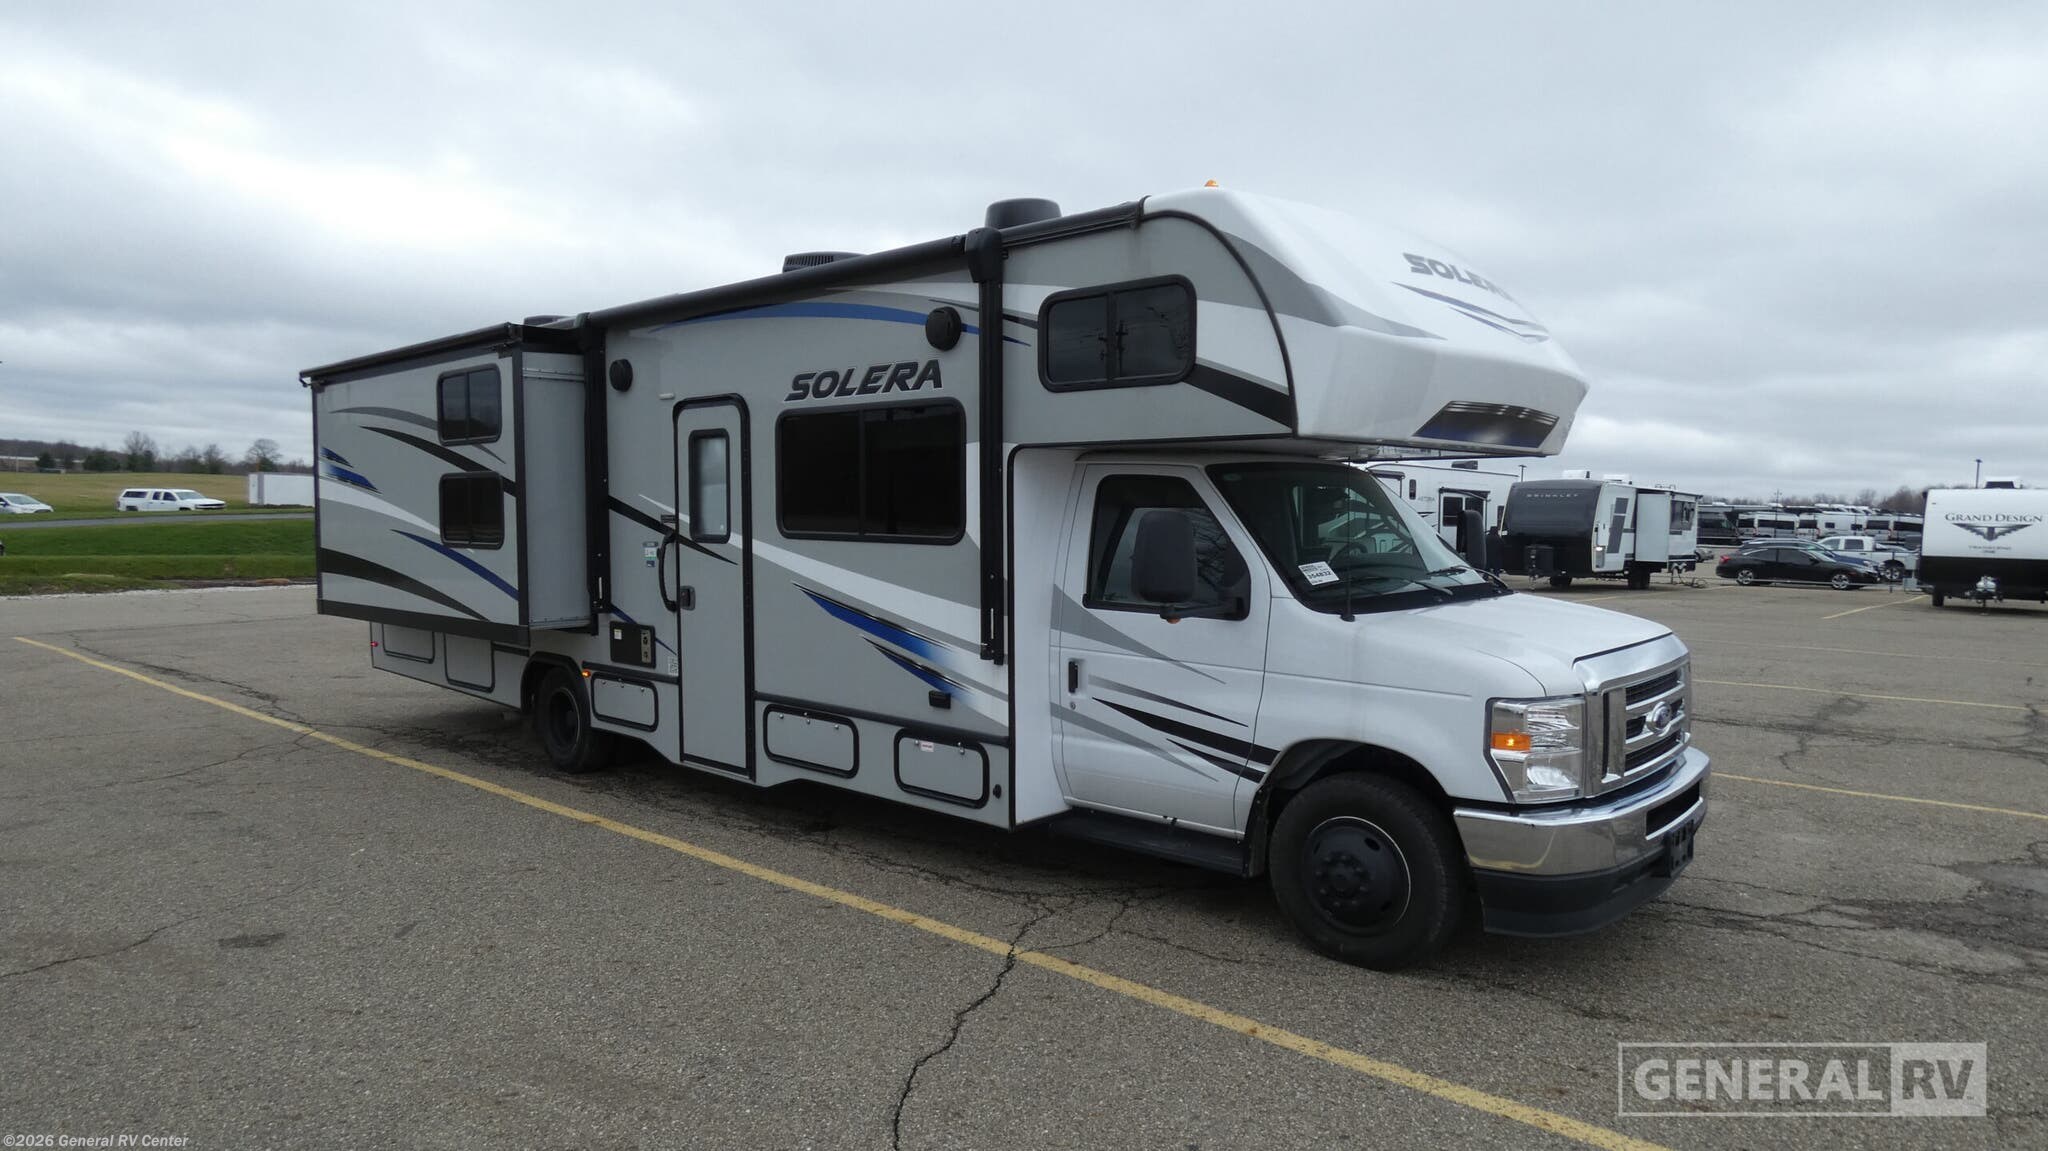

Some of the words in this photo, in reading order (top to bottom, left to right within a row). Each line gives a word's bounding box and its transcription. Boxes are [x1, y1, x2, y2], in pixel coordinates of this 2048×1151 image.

[784, 359, 943, 402] SOLERA
[1945, 512, 1992, 521] GRAND
[1995, 514, 2042, 522] DESIGN
